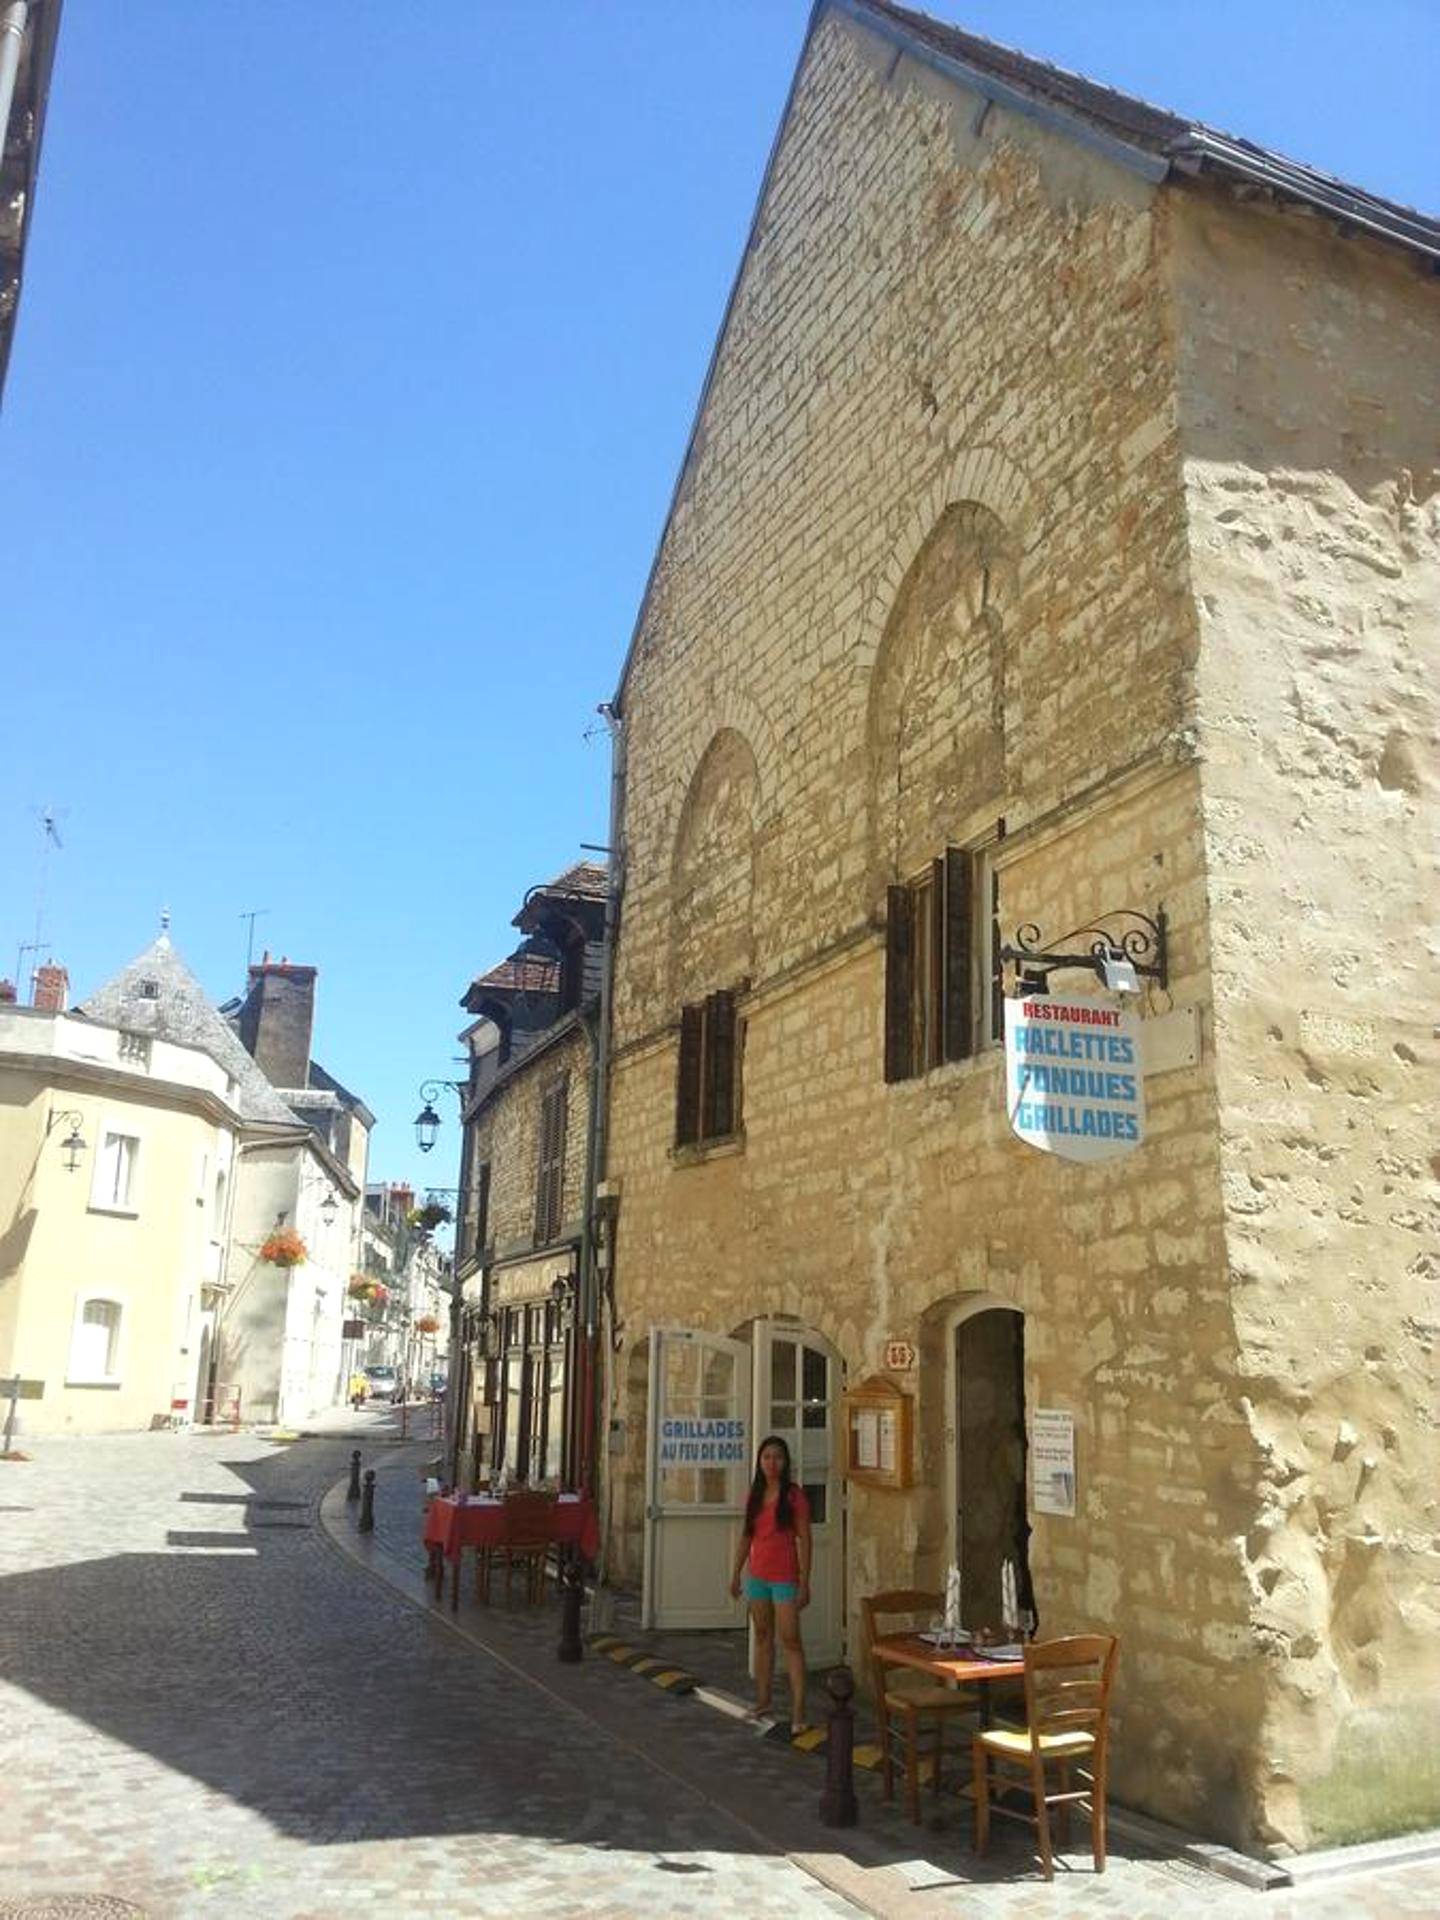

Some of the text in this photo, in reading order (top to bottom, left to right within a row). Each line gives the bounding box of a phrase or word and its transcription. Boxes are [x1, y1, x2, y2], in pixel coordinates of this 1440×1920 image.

[1023, 1002, 1120, 1027] RESTAURANT
[1015, 1026, 1133, 1063] RACLETTES
[1017, 1064, 1136, 1101] FONDUES
[1018, 1103, 1138, 1141] GRILLADES
[662, 1421, 744, 1438] GRILLADES
[661, 1442, 743, 1460] AU FEU DE BOIS
